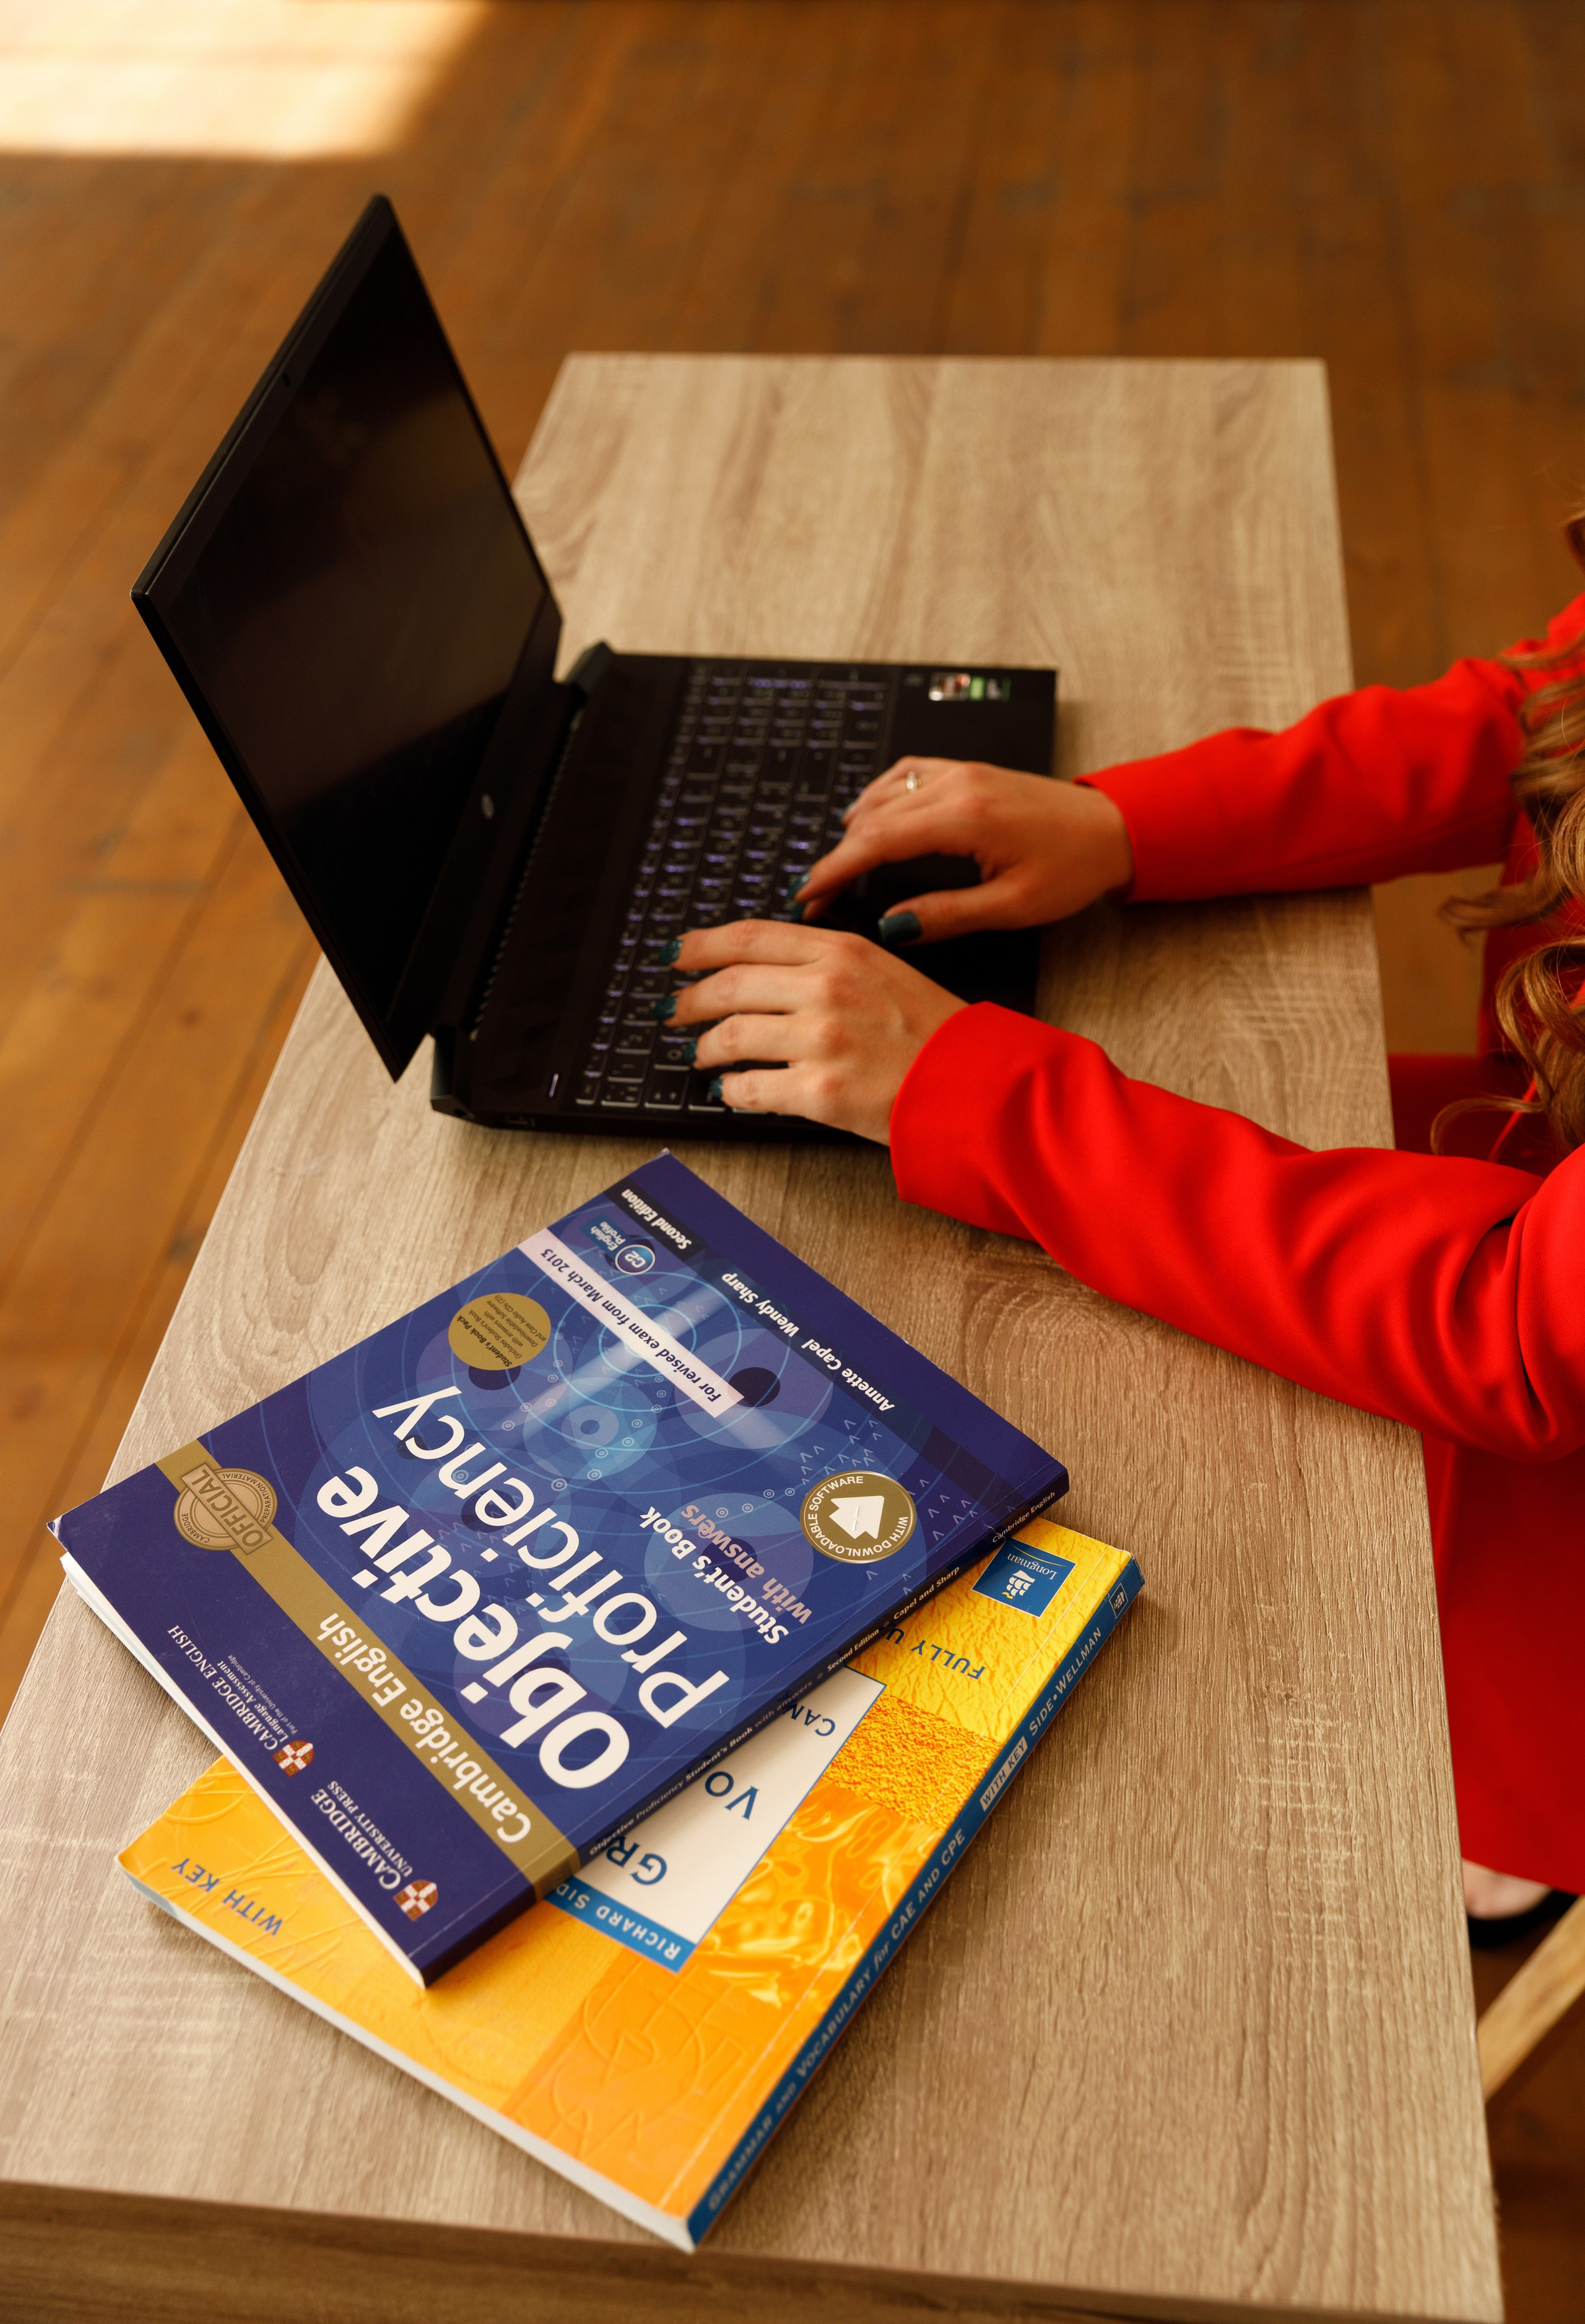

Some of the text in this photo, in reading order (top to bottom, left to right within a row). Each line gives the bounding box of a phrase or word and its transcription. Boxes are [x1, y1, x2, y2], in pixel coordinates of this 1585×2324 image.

[591, 1226, 618, 1251] English
[600, 1221, 626, 1245] Profile
[622, 1189, 692, 1250] Second Edition
[625, 1251, 646, 1268] C2
[484, 1311, 523, 1347] with answers with
[487, 1300, 538, 1347] Downloadable Software
[504, 1303, 513, 1312] CDs
[513, 1311, 527, 1323] Audio
[525, 1323, 537, 1334] Class
[541, 1248, 721, 1402] For revised exam from March 2013
[456, 1315, 513, 1367] Student's Book Pack
[469, 1309, 523, 1359] (includes Student's Book
[535, 1333, 547, 1341] and
[721, 1273, 895, 1411] Annette Capel Wendy Sharp
[191, 1468, 263, 1547] OFFICIAL
[222, 1473, 271, 1523] PREPARATION MATERIAL
[808, 1476, 908, 1557] WITH DOWNLOADABLE SOFTWARE
[992, 1492, 1055, 1543] Cambridge English
[181, 1513, 210, 1543] CAMBRIDGE
[372, 1385, 730, 1729] Proficiency
[640, 1506, 789, 1643] Student's Book
[681, 1505, 812, 1624] with answers
[1007, 1553, 1057, 1580] Longman
[316, 1466, 630, 1789] Objective
[228, 1654, 251, 1681] Cambridge
[910, 1640, 986, 1680] FULLY
[1030, 1627, 1102, 1736] SIDE WELLMAN
[167, 1625, 278, 1751] CAMBRIDGE ENGLISH
[217, 1661, 289, 1743] Language Assessment
[254, 1684, 276, 1710] University
[274, 1708, 284, 1717] the
[589, 1566, 960, 1855] Objective Proficiency Student's Book with answers Second Edition Capel and Sharp
[286, 1721, 298, 1734] Part
[316, 1612, 531, 1843] Cambridge English
[705, 1771, 760, 1820] VO
[983, 1743, 1026, 1807] WITH KEY
[311, 1788, 401, 1890] CAMBRIDGE
[328, 1781, 413, 1878] UNIVERSITY PRESS
[171, 1858, 284, 1937] WITH KEY
[596, 1905, 681, 1961] RICHARD
[797, 1968, 871, 2077] VOCABULARY
[874, 1940, 889, 1971] for
[891, 1900, 916, 1939] CAE
[918, 1868, 940, 1903] AND
[941, 1828, 965, 1866] CPE
